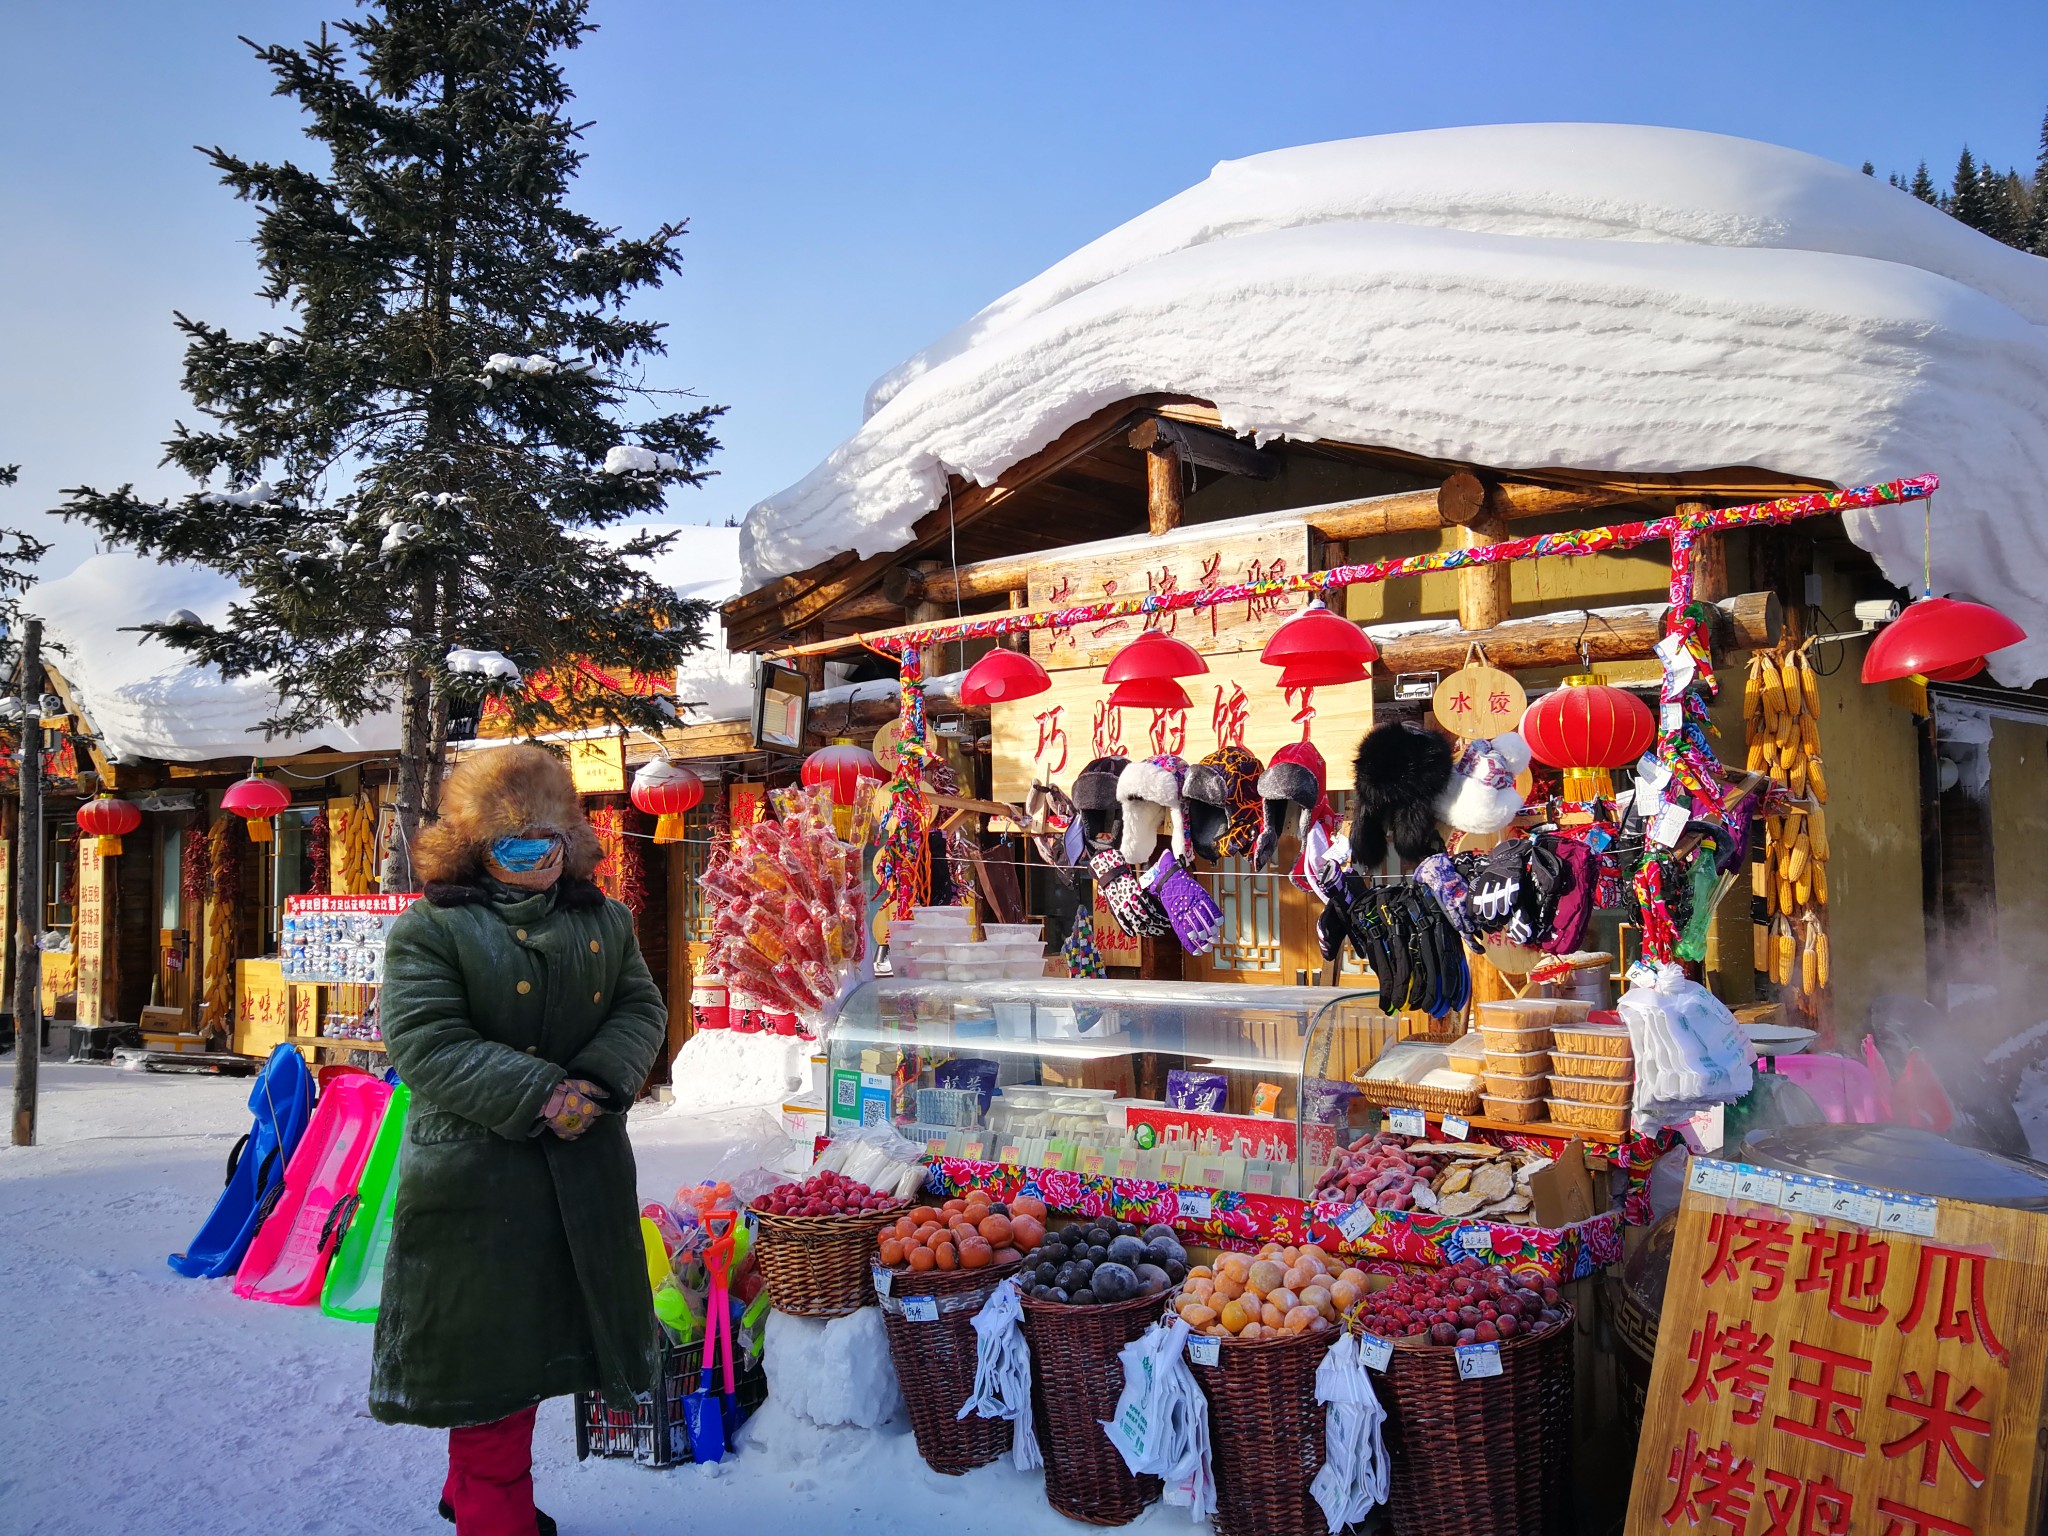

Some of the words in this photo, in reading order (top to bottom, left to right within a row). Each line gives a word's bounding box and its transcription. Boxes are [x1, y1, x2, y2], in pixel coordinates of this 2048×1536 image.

[1449, 690, 1512, 715] 水饺
[1696, 1170, 1709, 1184] 15
[1741, 1182, 1751, 1193] 10
[1787, 1191, 1802, 1203] 5
[1833, 1199, 1850, 1211] 15
[1886, 1212, 1901, 1223] 10
[1701, 1200, 2010, 1367] 烤地瓜
[1192, 1344, 1202, 1359] 15
[1363, 1344, 1373, 1357] 15
[1460, 1357, 1475, 1374] 15
[1681, 1309, 1992, 1489] 烤玉米
